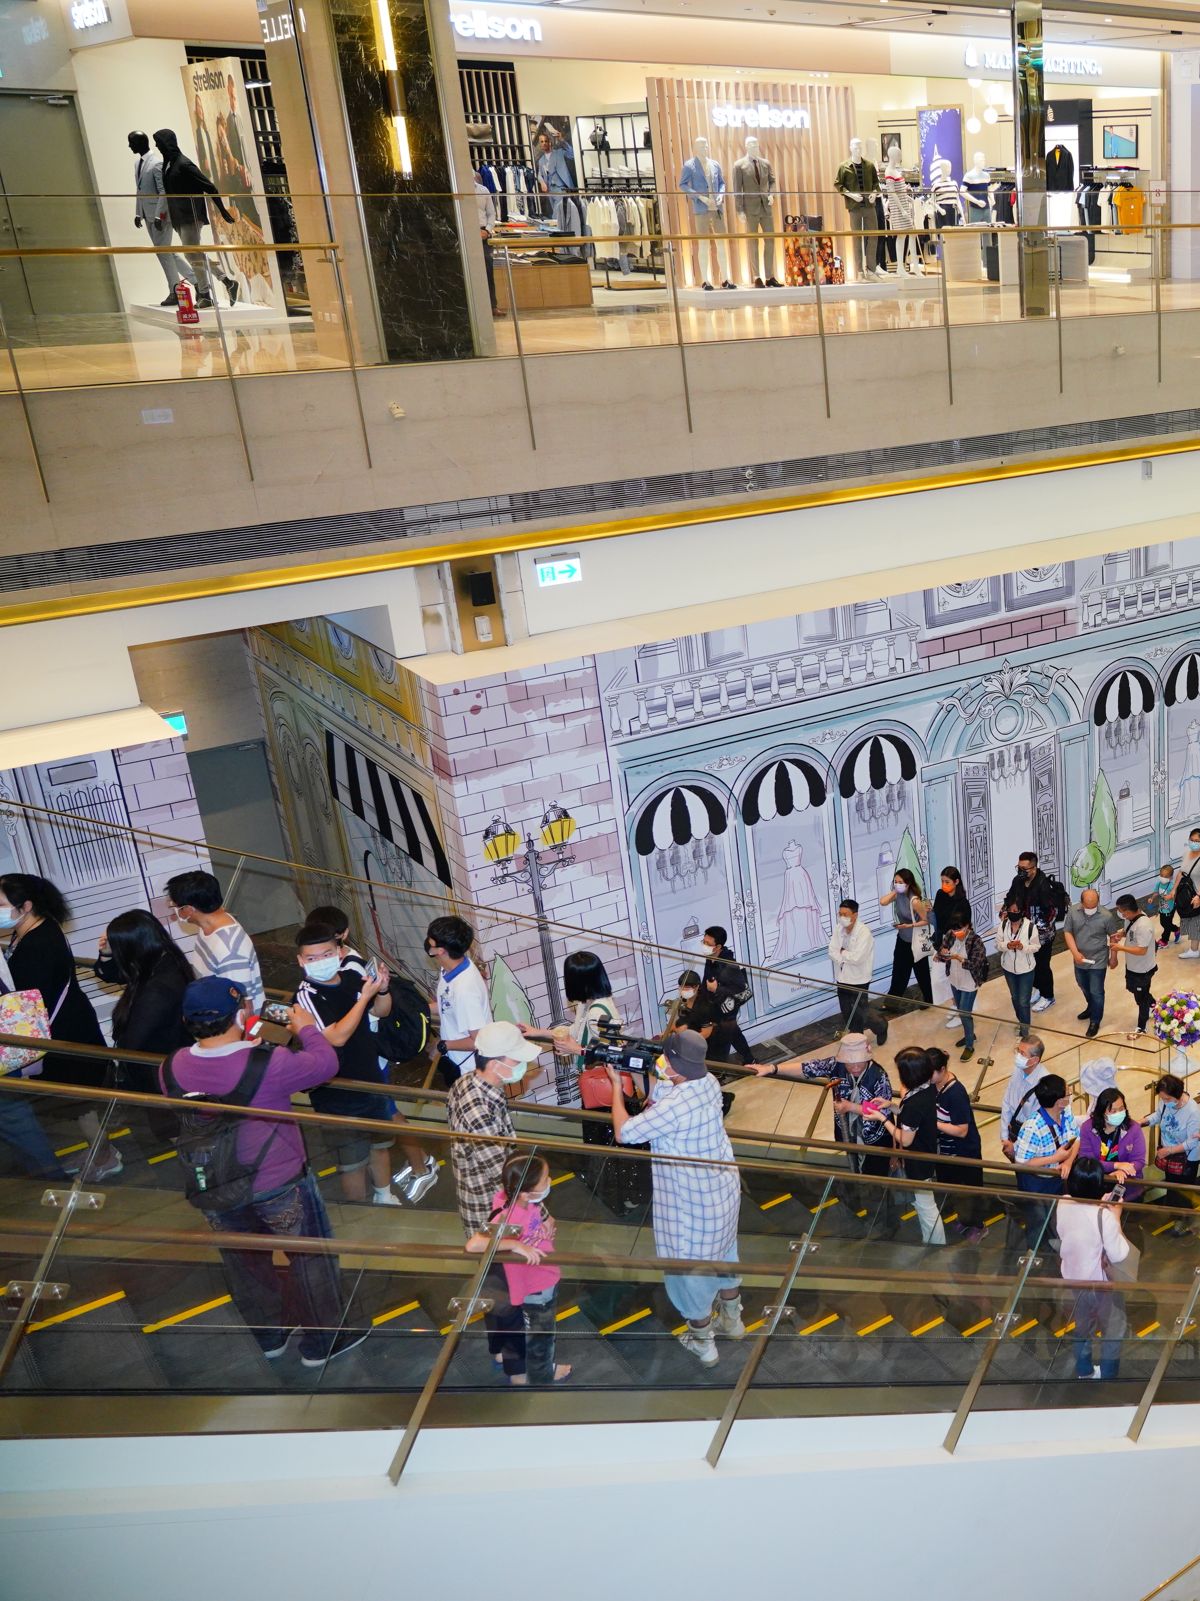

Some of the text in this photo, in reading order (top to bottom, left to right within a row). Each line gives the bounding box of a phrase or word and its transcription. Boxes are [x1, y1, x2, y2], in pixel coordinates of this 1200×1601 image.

[1044, 55, 1099, 75] ACHTING
[193, 67, 225, 92] strellson
[711, 103, 810, 129] strellson
